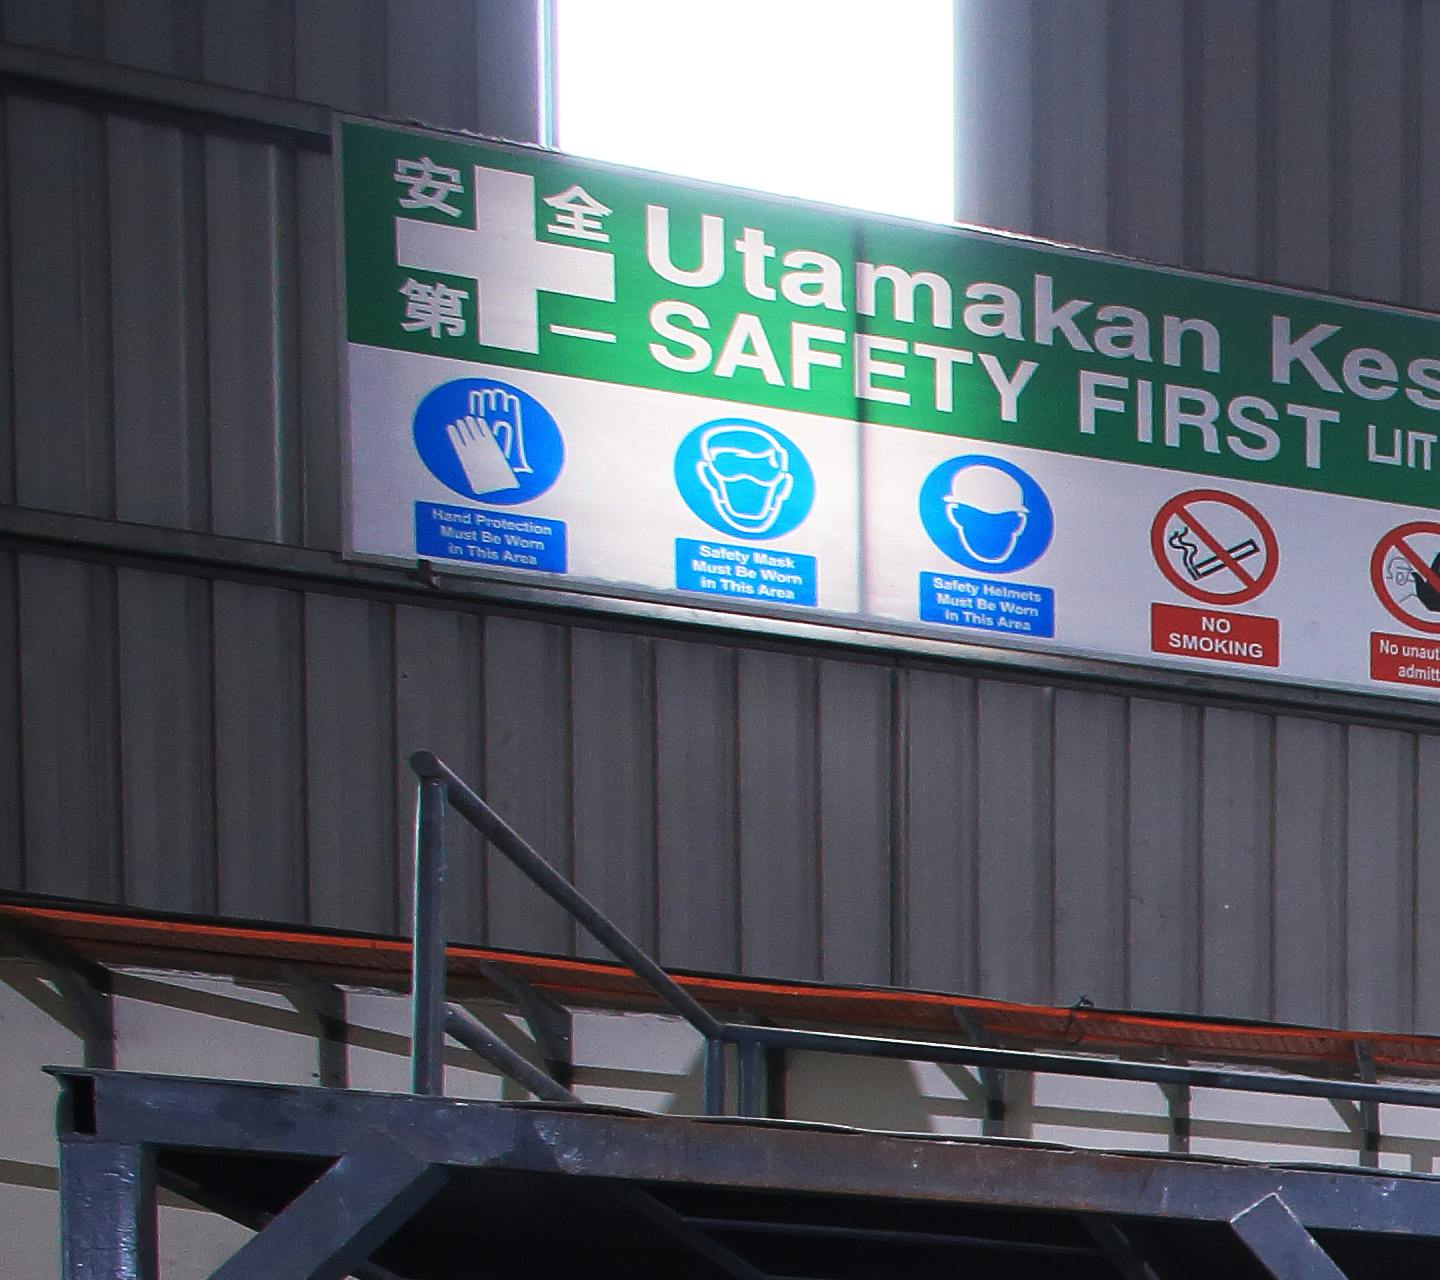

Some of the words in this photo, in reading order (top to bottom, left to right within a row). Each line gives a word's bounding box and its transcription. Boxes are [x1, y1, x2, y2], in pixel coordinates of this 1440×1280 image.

[646, 203, 1220, 373] Utamakan
[648, 299, 1042, 424] SAFETY
[1079, 369, 1340, 469] FIRST
[432, 508, 472, 524] Hand
[475, 514, 553, 536] Protection
[440, 525, 478, 542] Must
[482, 531, 501, 545] Be
[504, 534, 545, 551] Worn
[467, 545, 500, 560] This
[503, 550, 538, 566] Area
[699, 545, 750, 565] Safety
[752, 551, 796, 569] Mask
[691, 559, 732, 576] Must
[735, 565, 757, 579] Be
[760, 569, 804, 585] Worn
[720, 578, 755, 596] This
[757, 584, 796, 600] Area
[932, 577, 980, 597] Safety
[982, 584, 1043, 603] Helmets
[935, 592, 974, 609] Must
[975, 597, 997, 612] Be
[999, 600, 1039, 617] Worn
[963, 611, 994, 626] This
[997, 617, 1032, 631] Area
[1201, 616, 1231, 634] NO
[1168, 632, 1264, 659] SMOKING
[1379, 639, 1399, 655] No
